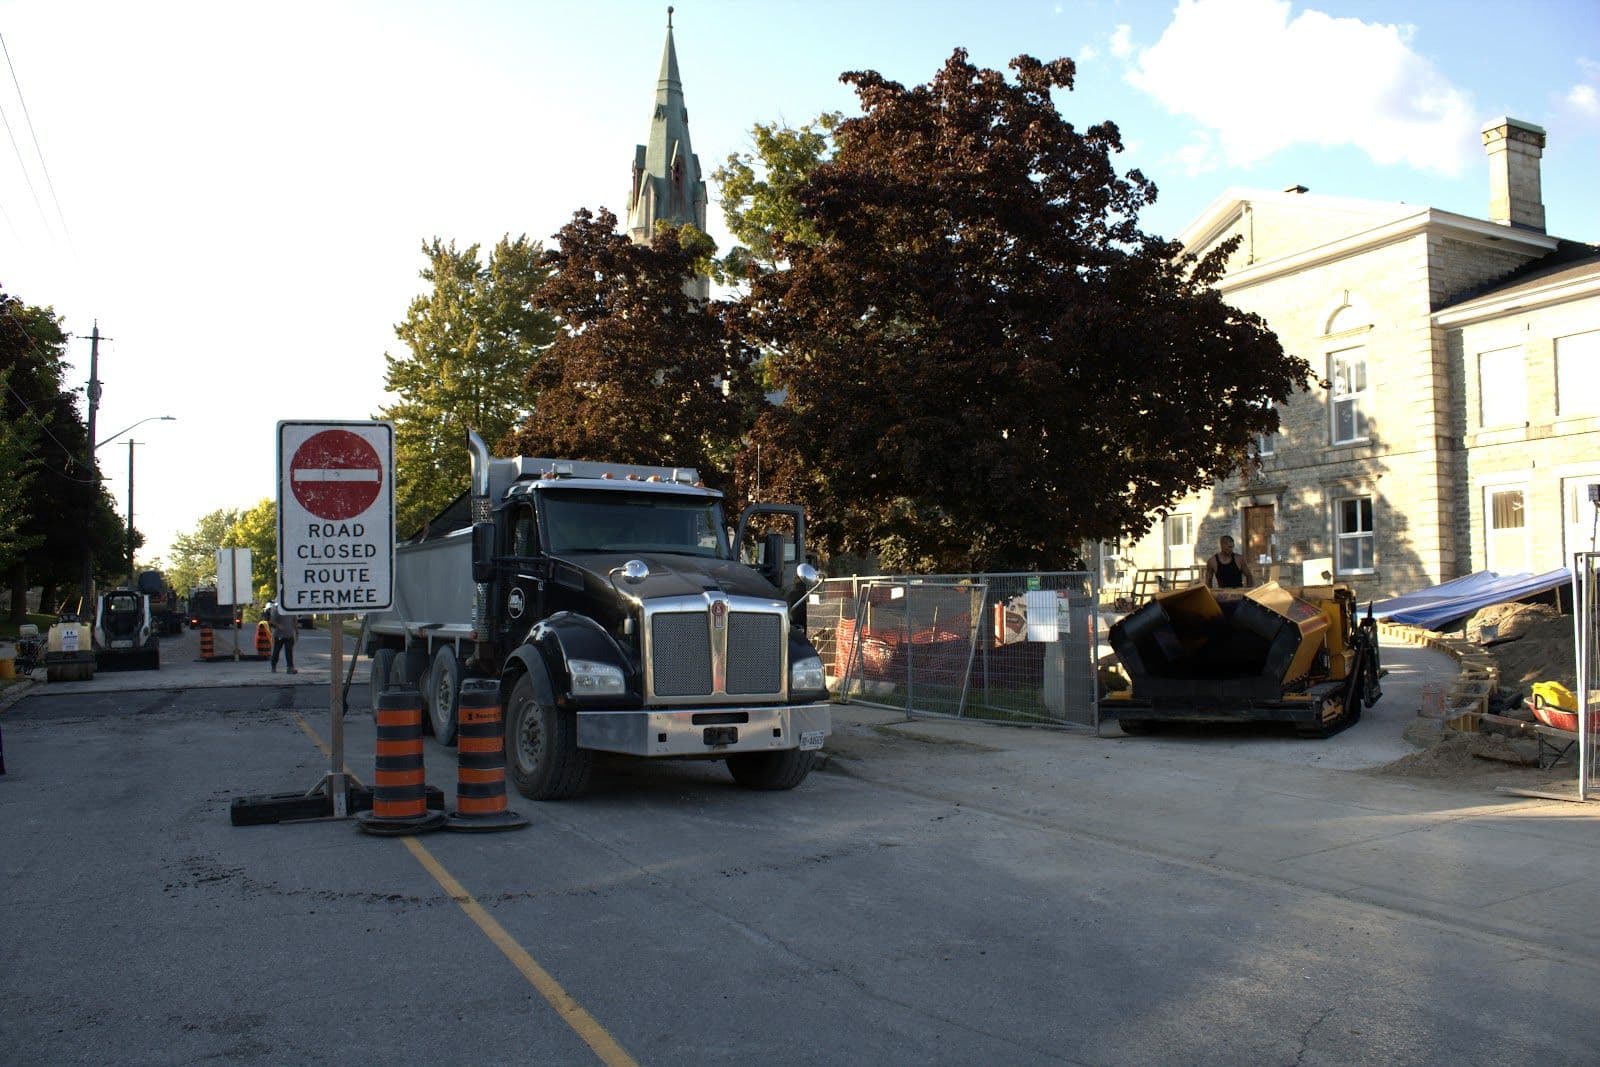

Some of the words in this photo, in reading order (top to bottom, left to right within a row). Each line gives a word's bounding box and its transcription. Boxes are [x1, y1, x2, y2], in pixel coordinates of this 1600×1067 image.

[309, 523, 365, 538] ROAD
[297, 544, 376, 559] CLOSED
[304, 568, 370, 584] ROUTE
[297, 586, 377, 604] FERMÉE
